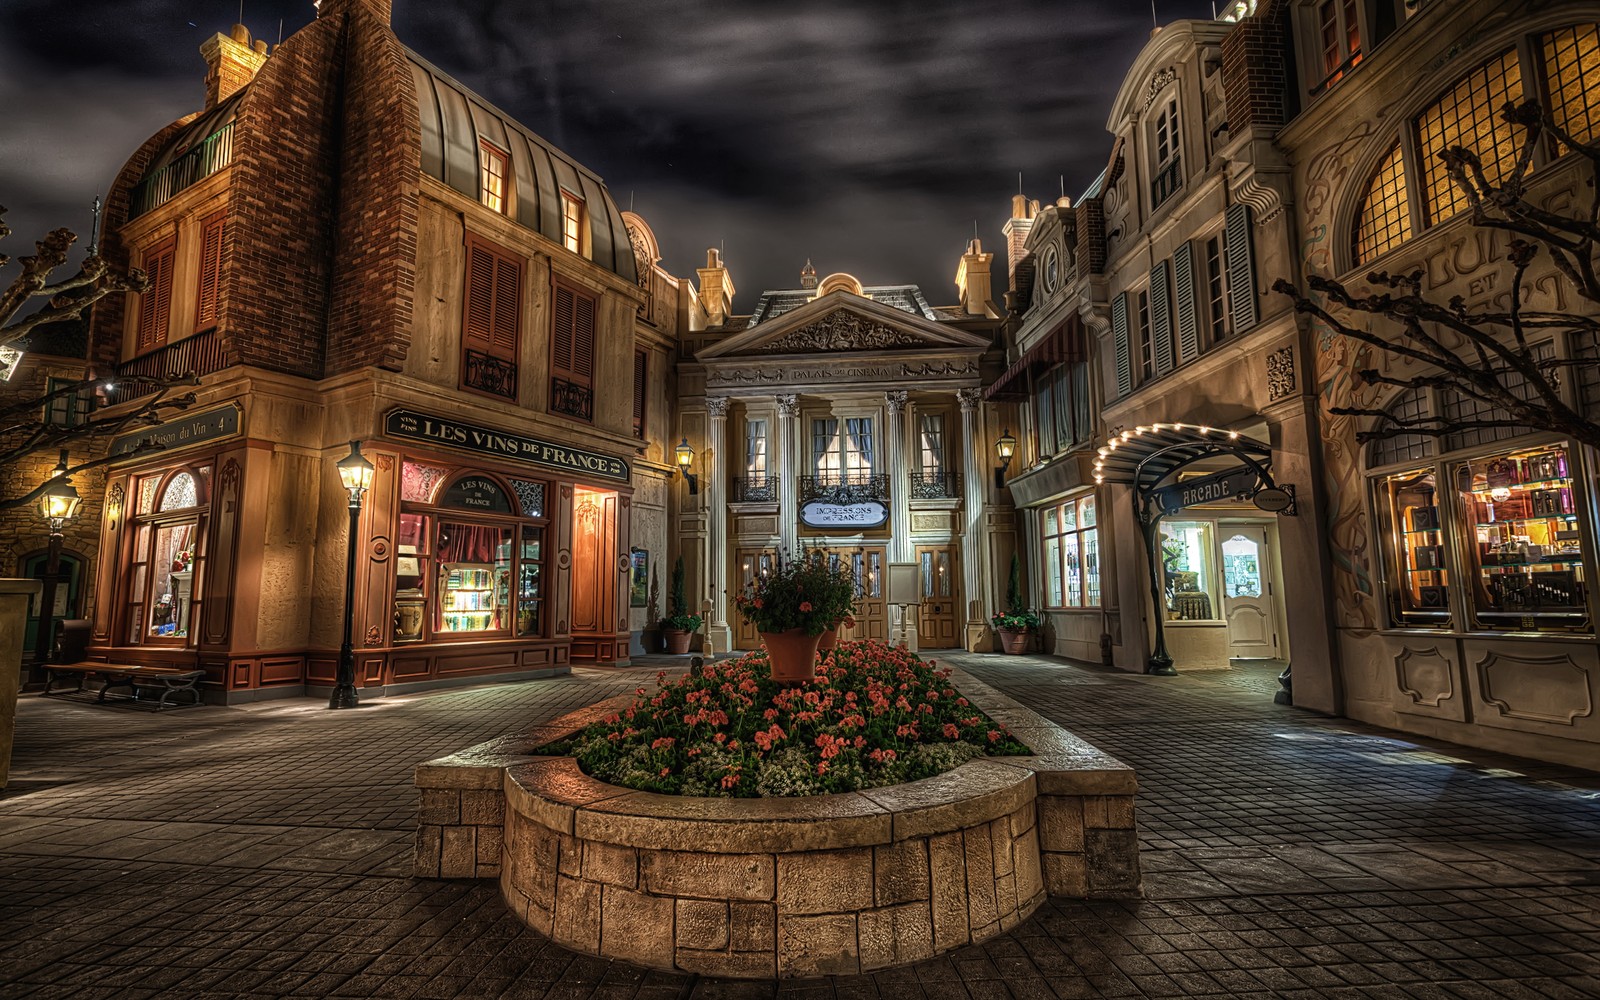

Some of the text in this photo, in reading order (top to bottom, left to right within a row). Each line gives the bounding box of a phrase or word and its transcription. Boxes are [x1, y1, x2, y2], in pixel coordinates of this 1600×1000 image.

[1469, 272, 1497, 297] ET
[793, 369, 832, 379] PALAIS
[847, 367, 889, 377] CINEMA
[180, 426, 190, 439] du
[192, 422, 206, 436] Vin
[218, 417, 225, 432] 4
[400, 416, 418, 426] VINS
[424, 420, 608, 472] LES VINS DE FRANCE
[461, 480, 497, 494] LES VINS
[1183, 480, 1230, 505] ARCADE
[465, 497, 491, 506] FRANCE
[816, 507, 872, 515] IMPRESSIONS
